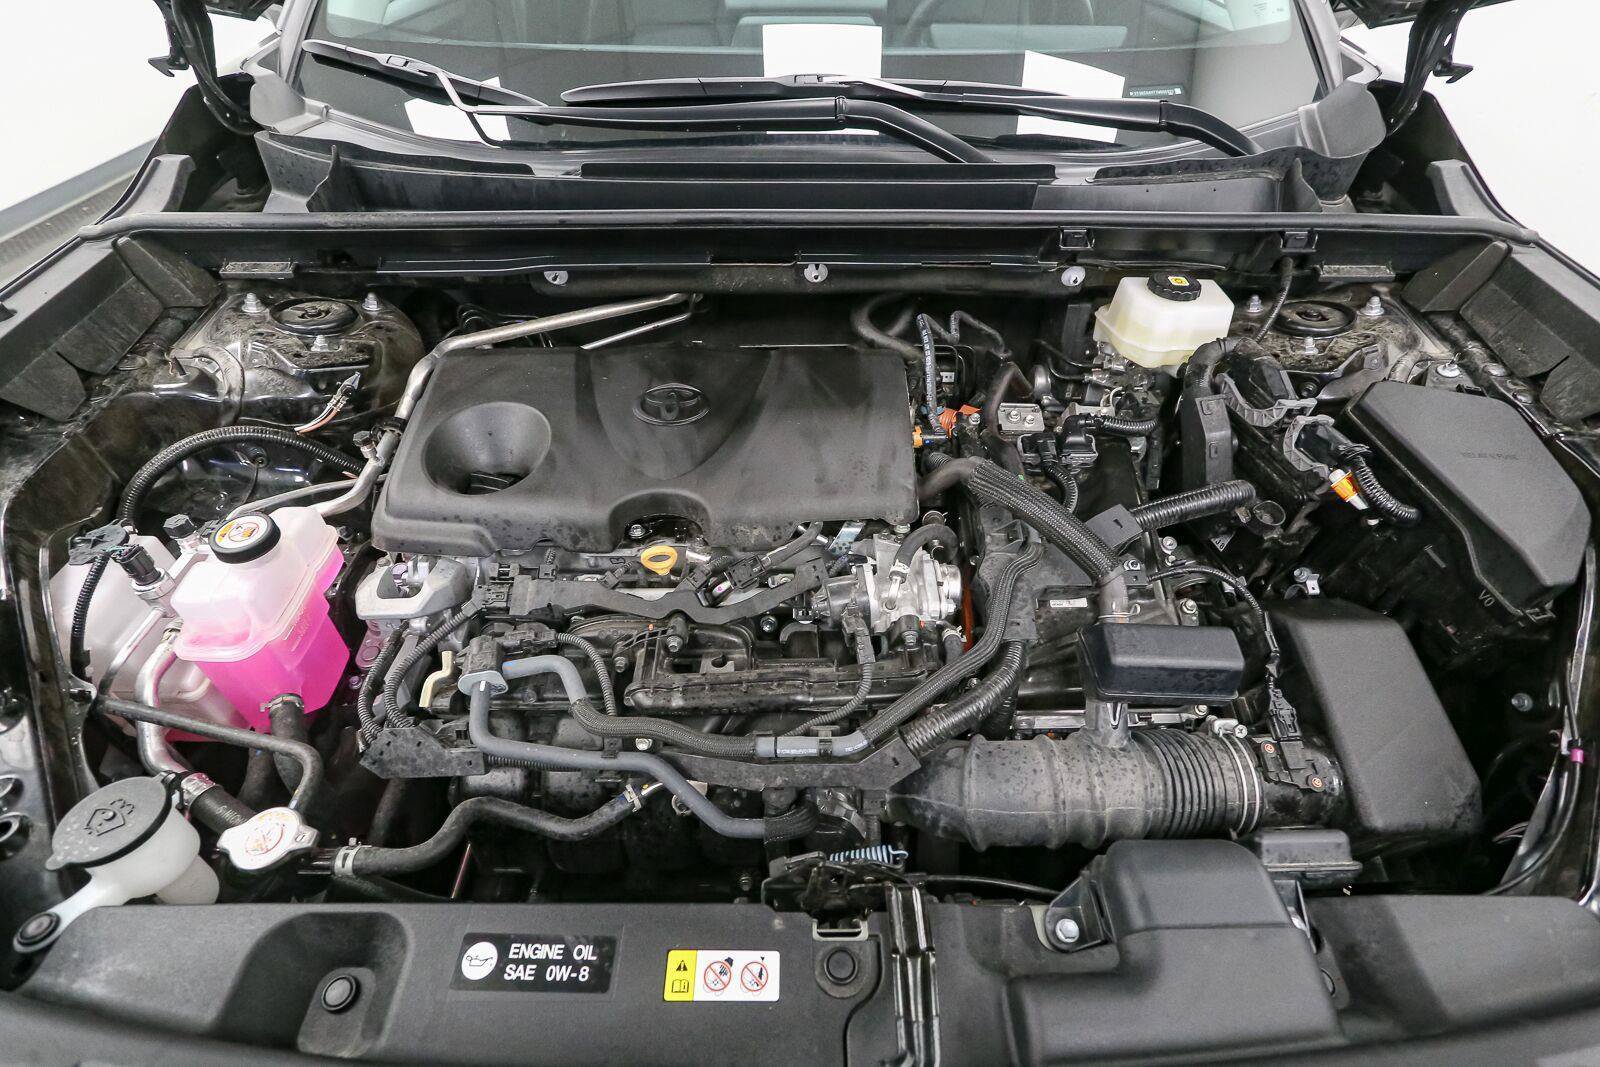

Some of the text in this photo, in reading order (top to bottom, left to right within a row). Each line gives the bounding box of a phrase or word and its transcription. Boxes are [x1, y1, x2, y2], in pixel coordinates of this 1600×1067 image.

[508, 943, 598, 961] ENGINE OIL
[503, 963, 590, 982] SAE 0W-8
